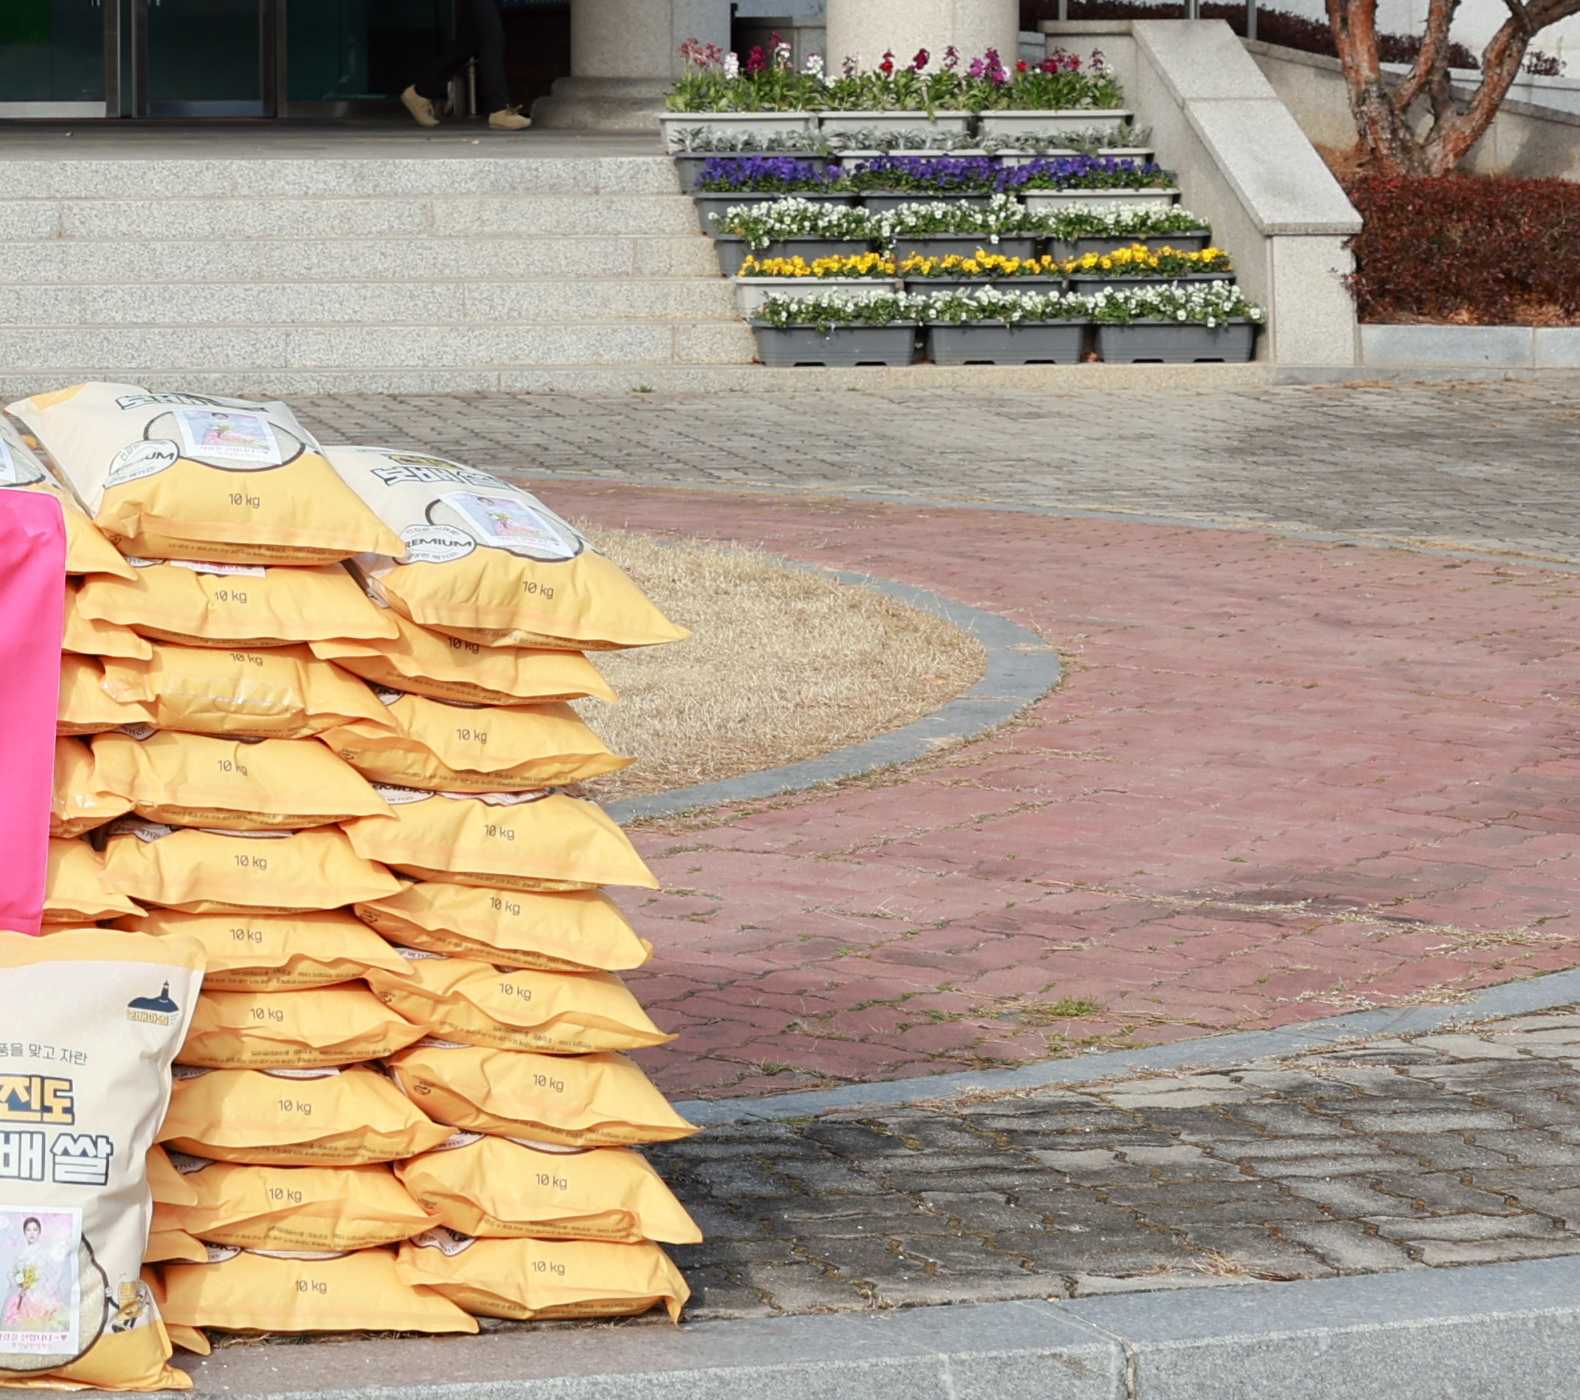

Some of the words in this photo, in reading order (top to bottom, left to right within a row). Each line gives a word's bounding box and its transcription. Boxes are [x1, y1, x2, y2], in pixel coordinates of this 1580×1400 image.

[229, 493, 242, 504] 10
[246, 493, 260, 508] kg
[405, 538, 473, 549] REMIUM
[214, 591, 228, 601] 10
[232, 591, 247, 604] kg
[523, 581, 536, 594] 10
[540, 585, 554, 599] kg
[448, 637, 462, 649] 10
[465, 640, 479, 654] kg
[231, 653, 244, 662] 10
[248, 655, 263, 666] kg
[457, 729, 470, 740] 10
[474, 730, 487, 744] kg
[217, 760, 232, 772] 10
[484, 825, 497, 837] 10
[499, 826, 514, 840] kg
[235, 855, 249, 866] 10
[252, 855, 267, 870] kg
[490, 897, 502, 909] 10
[505, 901, 521, 916] kg
[230, 929, 244, 940] 10
[248, 929, 262, 943] kg
[499, 982, 513, 995] 10
[516, 987, 531, 1001] kg
[250, 1008, 264, 1019] 10
[269, 1008, 283, 1021] kg
[28, 1044, 55, 1061] 맞고
[60, 1049, 88, 1066] 자란
[533, 1074, 547, 1086] 10
[549, 1079, 564, 1093] kg
[278, 1100, 292, 1111] 10
[296, 1101, 312, 1115] kg
[52, 1131, 112, 1186] 쌀
[535, 1174, 549, 1186] 10
[552, 1176, 567, 1190] kg
[269, 1188, 283, 1199] 10
[287, 1189, 302, 1202] kg
[532, 1261, 546, 1272] 10
[550, 1261, 565, 1276] kg
[295, 1280, 308, 1292] 10
[312, 1281, 327, 1294] kg
